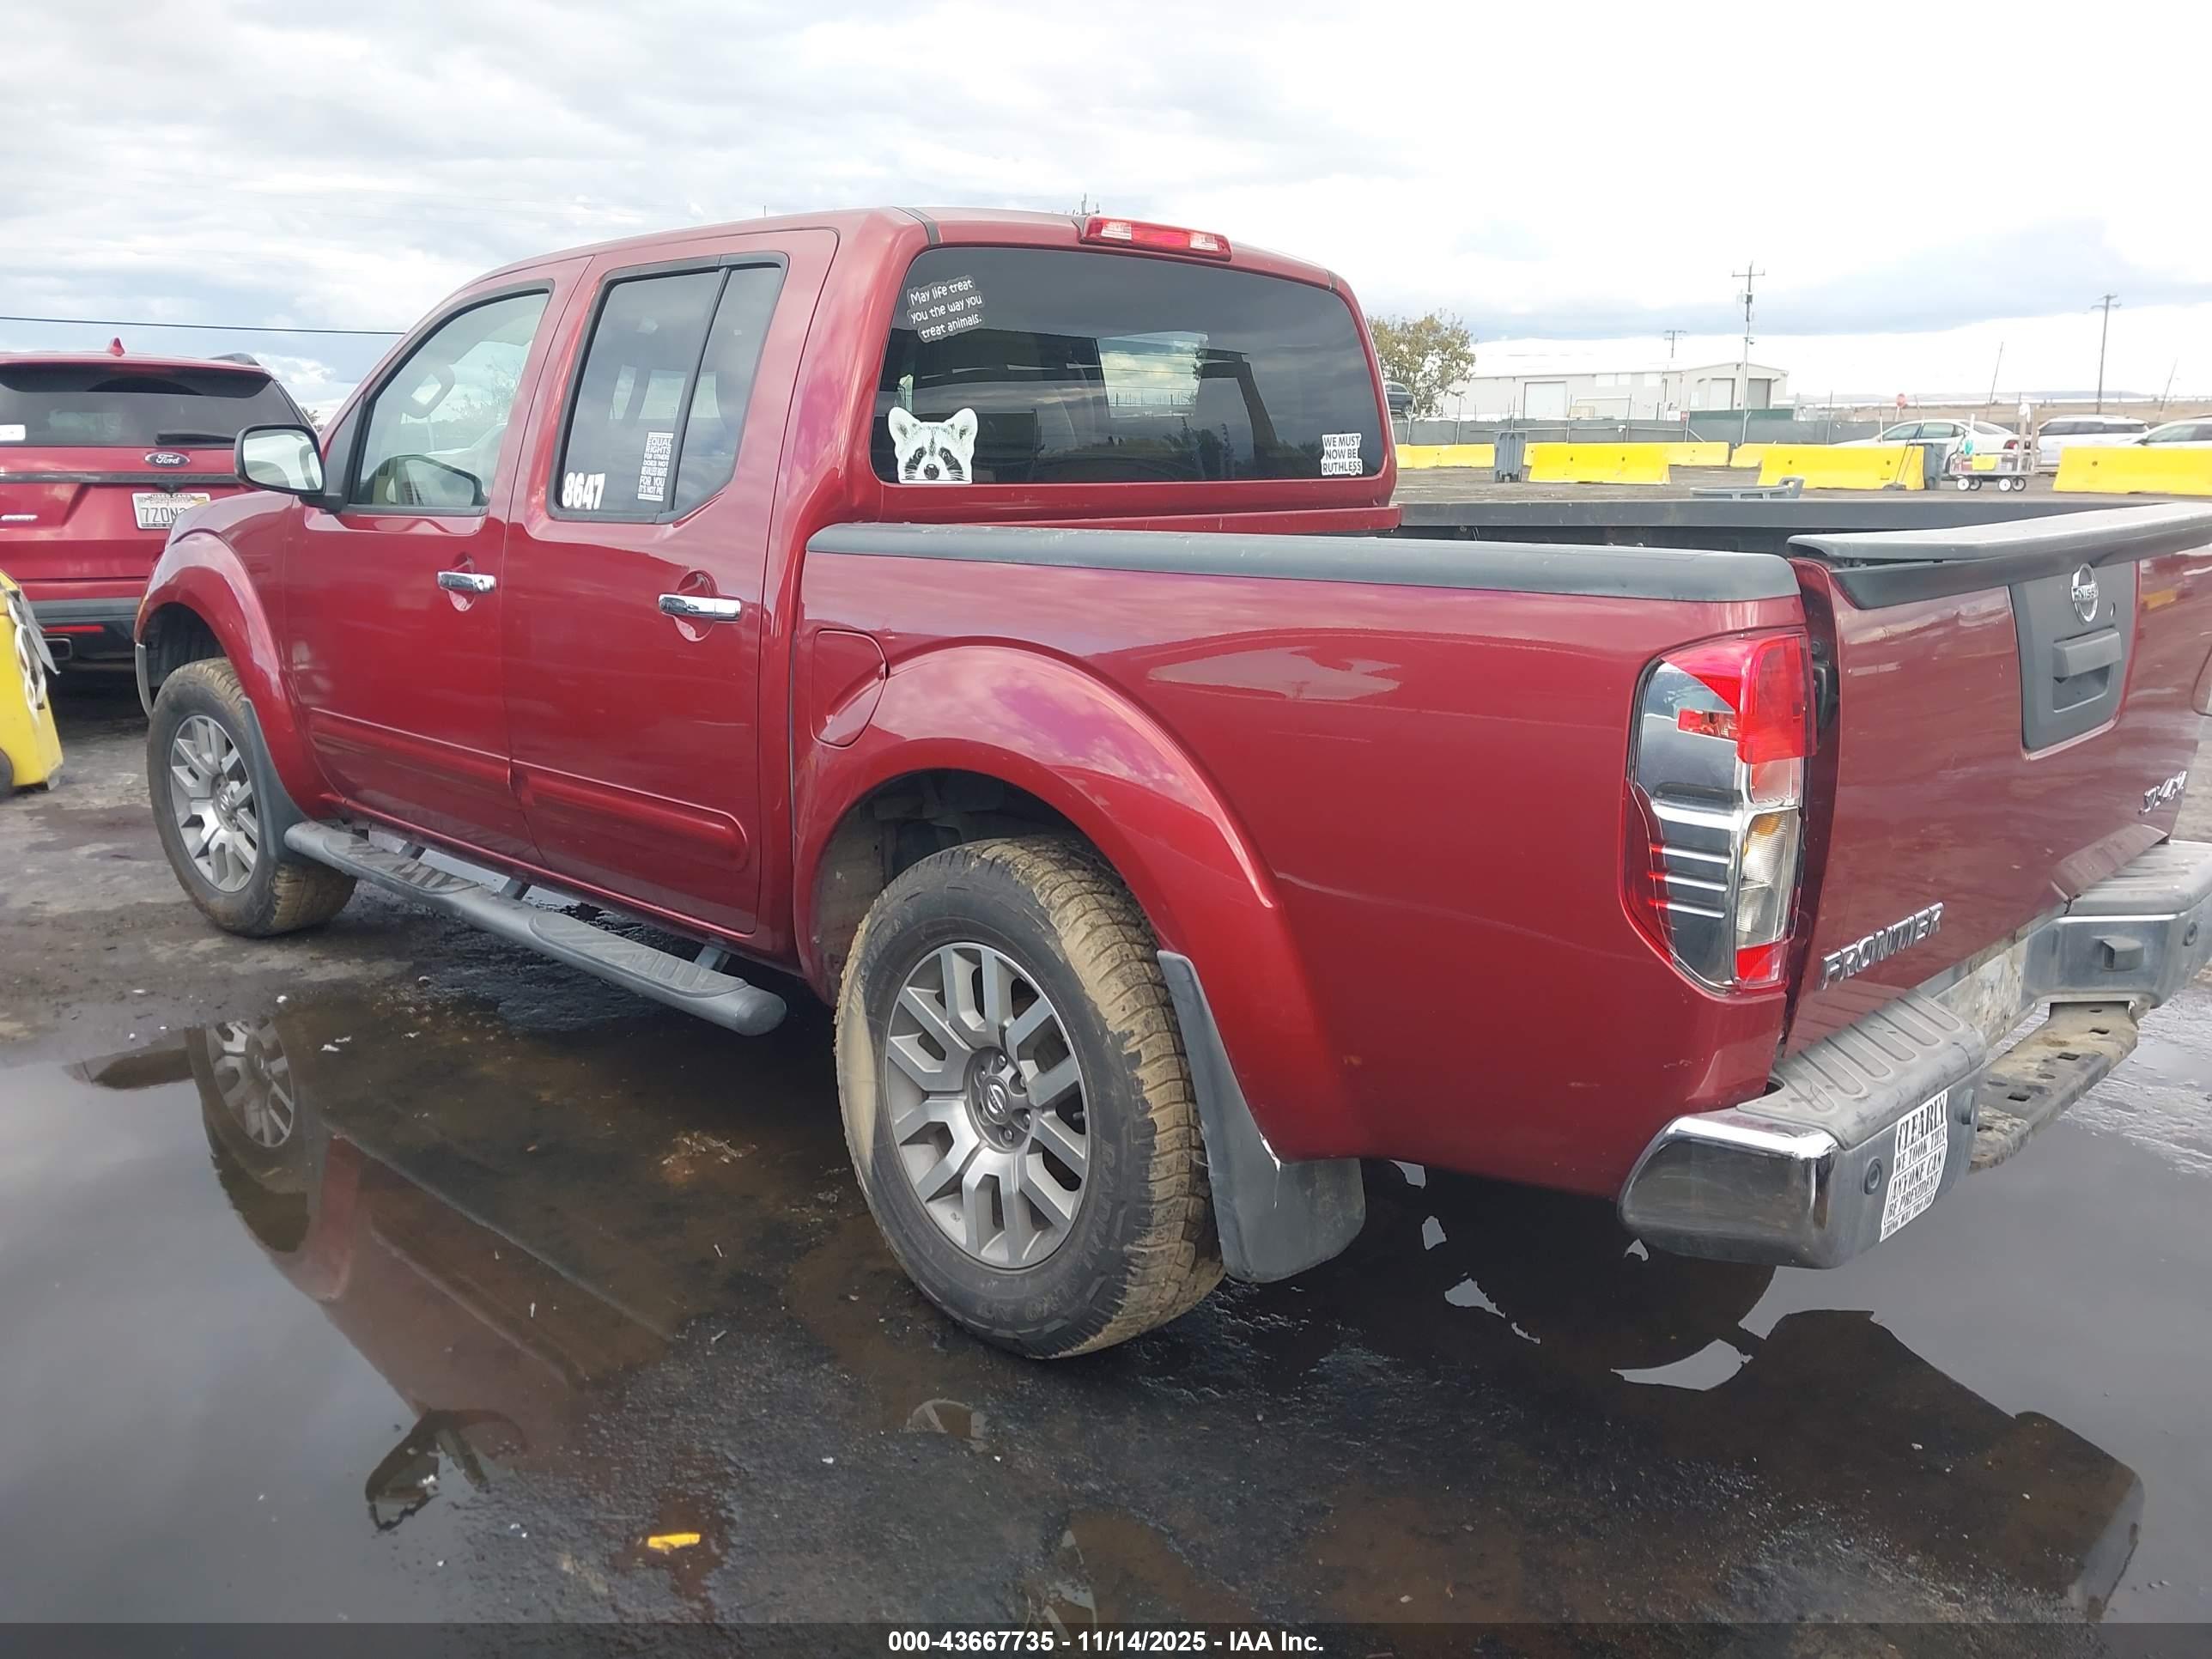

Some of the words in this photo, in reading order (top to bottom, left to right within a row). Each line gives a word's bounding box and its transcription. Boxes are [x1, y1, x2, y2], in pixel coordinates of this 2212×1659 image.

[910, 290, 930, 306] May
[932, 286, 947, 300] life
[949, 279, 973, 293] treat
[910, 310, 928, 325] you
[929, 305, 946, 318] the
[947, 299, 964, 313] way
[965, 295, 982, 308] you
[921, 324, 946, 338] treat
[947, 313, 982, 331] animals.
[646, 446, 671, 454] RIGHTS
[647, 438, 672, 447] EQUAL
[1323, 436, 1337, 447] WE
[1339, 435, 1360, 447] MUST
[1325, 448, 1346, 460] NOW
[1347, 448, 1357, 459] BE
[155, 453, 181, 465] Ford
[1322, 461, 1361, 473] RUTHLESS
[562, 472, 605, 510] 8647
[640, 476, 652, 486] FOR
[653, 477, 665, 487] YOU
[1821, 902, 1944, 990] FRONTIER
[1897, 1092, 1946, 1155] CLEARLY
[1895, 1152, 1906, 1174] WE
[1908, 1140, 1928, 1166] TOOK
[1929, 1127, 1946, 1152] THIS
[1890, 1164, 1925, 1200] ANYONE
[1926, 1148, 1945, 1179] CAN
[1888, 1200, 1899, 1218] BE
[1899, 1171, 1940, 1216] PRESIDENT
